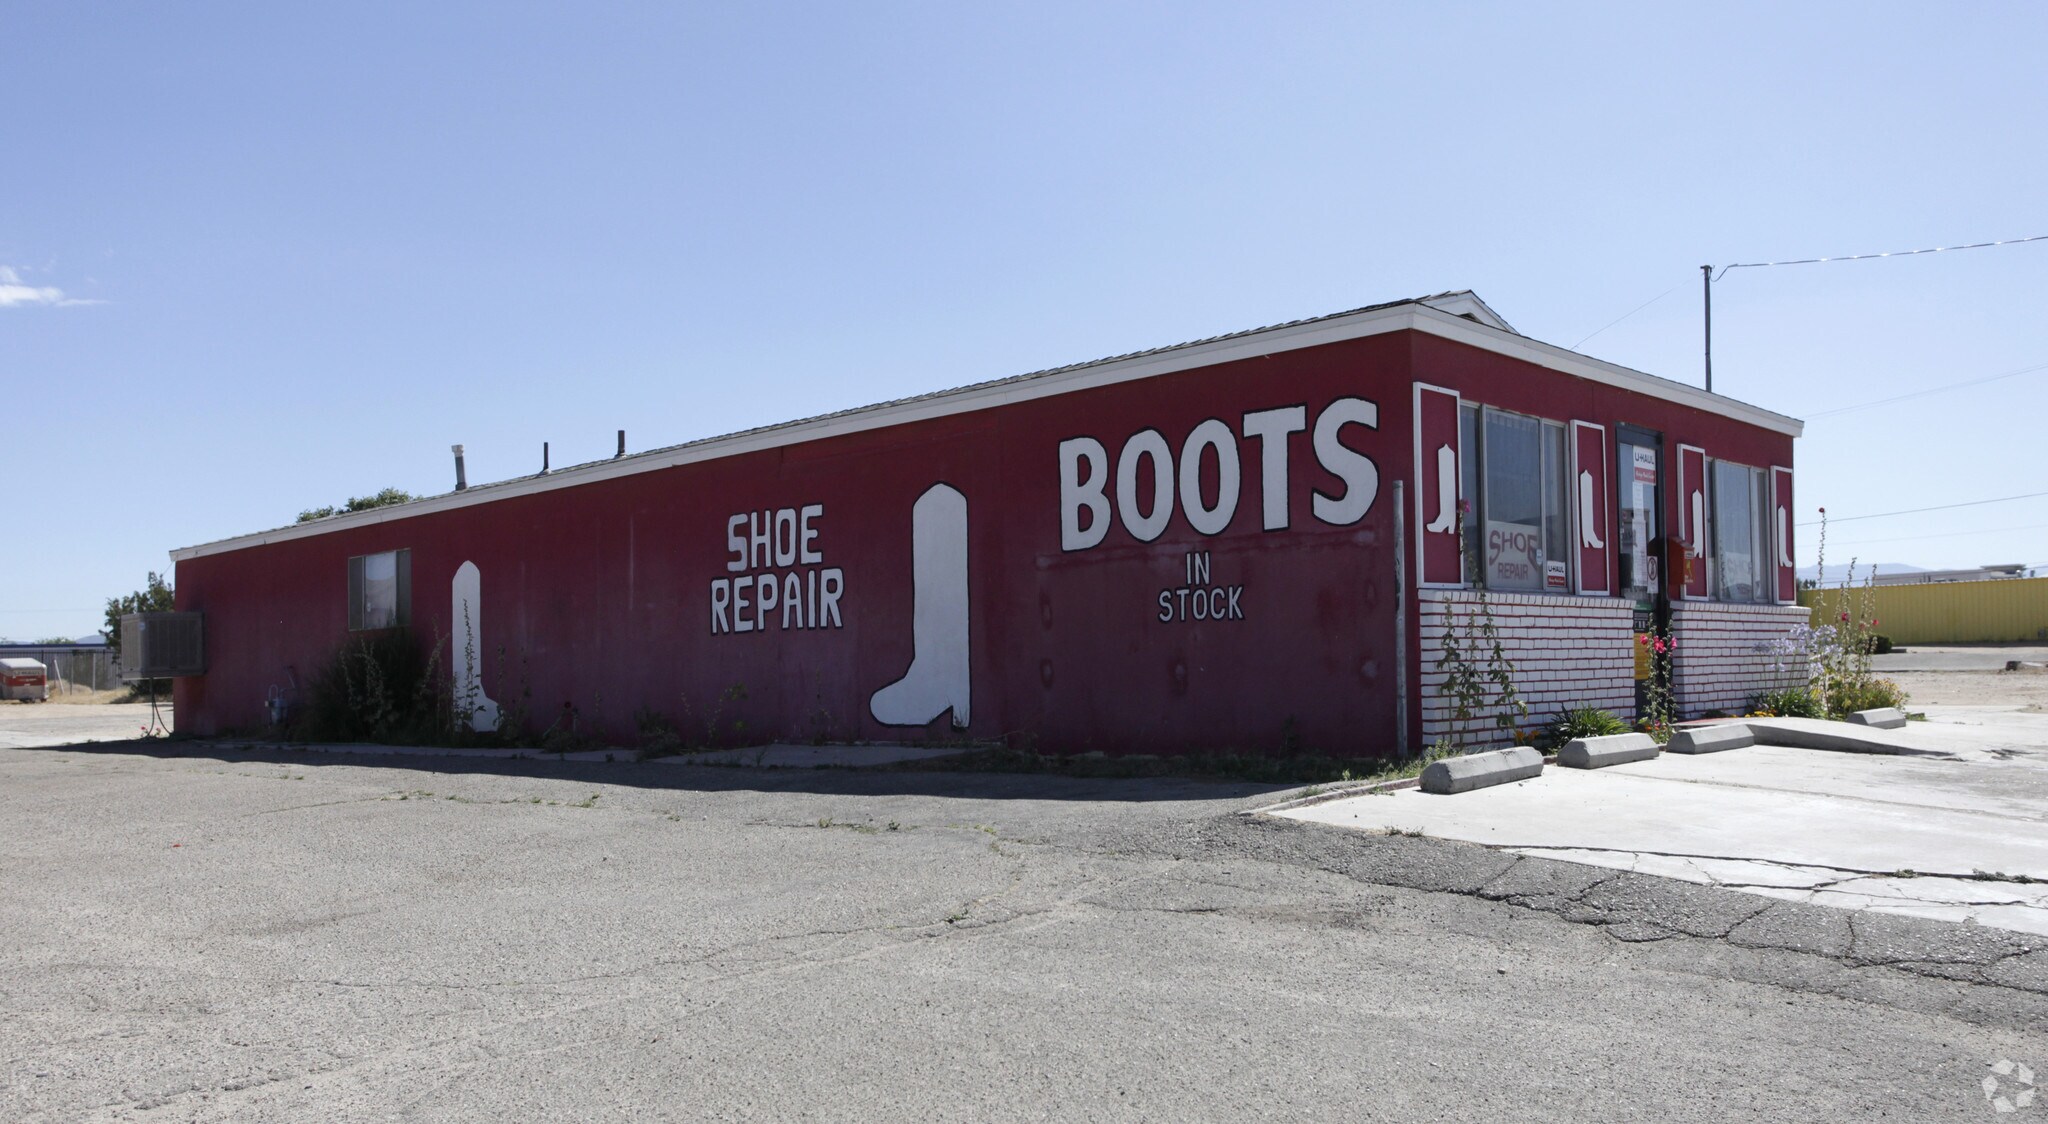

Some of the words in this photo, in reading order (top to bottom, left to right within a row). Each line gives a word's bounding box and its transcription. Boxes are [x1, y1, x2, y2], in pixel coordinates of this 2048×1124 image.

[1058, 396, 1380, 552] BOOTS
[726, 502, 824, 573] SHOE
[1489, 529, 1539, 574] SHOE
[1185, 551, 1211, 585] IN
[1497, 562, 1529, 580] REPAIR
[710, 567, 845, 634] REPAIR
[1157, 585, 1244, 623] STOCK
